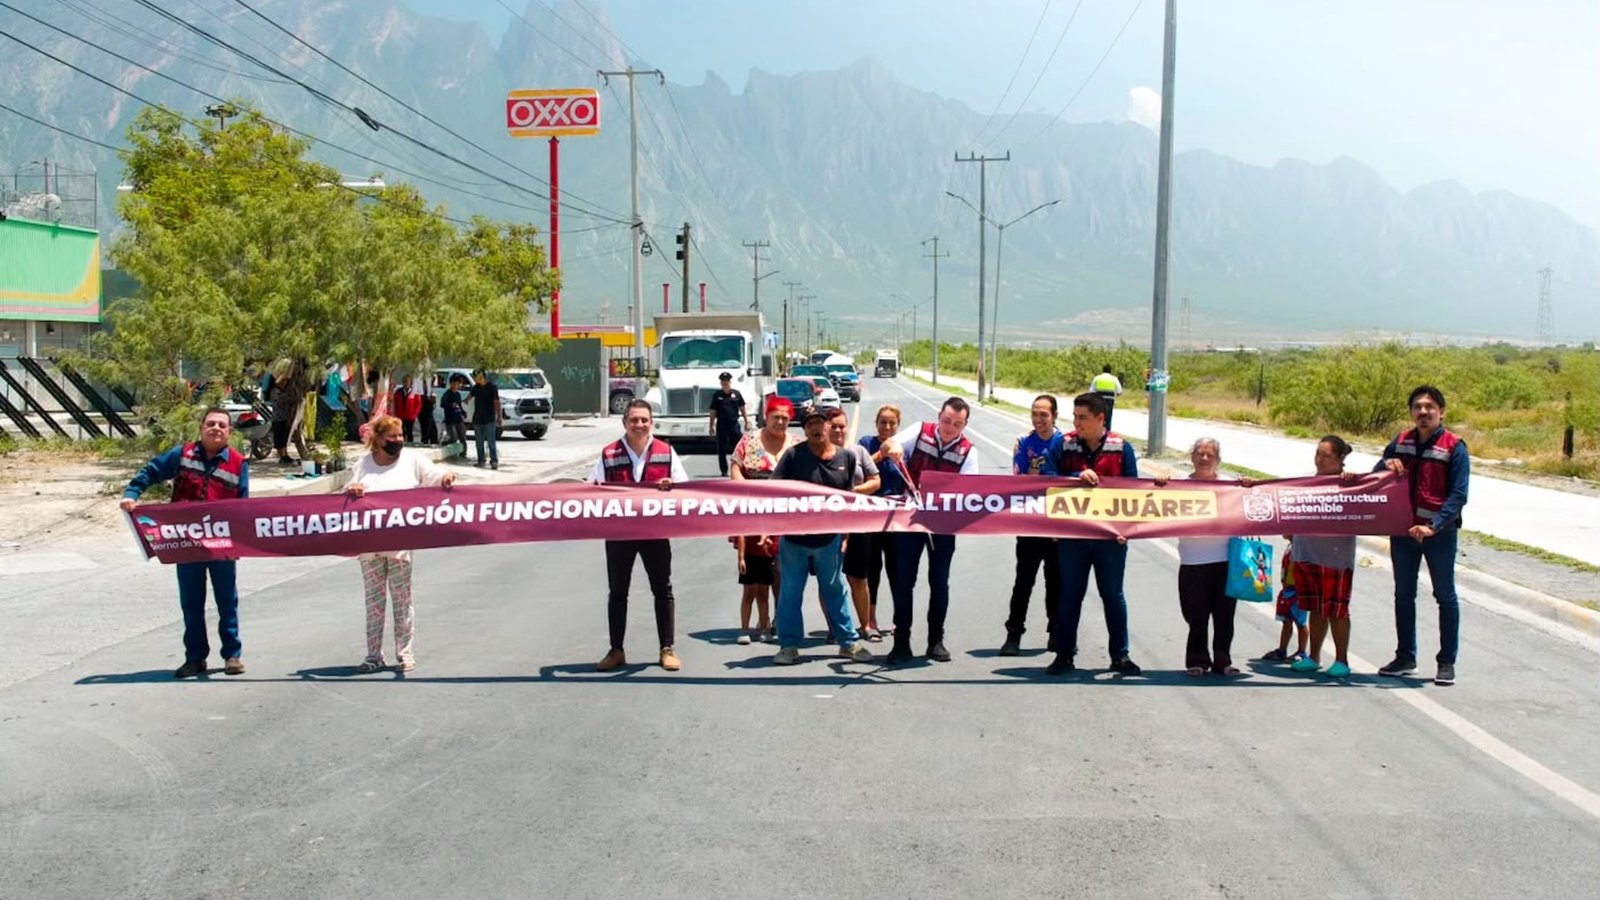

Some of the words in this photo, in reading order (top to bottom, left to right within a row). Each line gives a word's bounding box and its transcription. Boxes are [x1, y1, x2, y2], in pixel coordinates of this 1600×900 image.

[510, 97, 594, 128] OXXO
[1280, 495, 1295, 503] de
[1297, 493, 1388, 503] Infraestructura
[1280, 503, 1344, 513] Sostenible
[255, 498, 473, 538] REHABILITACIÓN
[479, 498, 636, 523] FUNCIONAL
[643, 498, 676, 517] DE
[686, 494, 847, 516] PAVIMENTO
[1010, 495, 1046, 514] EN
[1051, 496, 1100, 516] AV.
[1104, 491, 1211, 518] JUÁREZ
